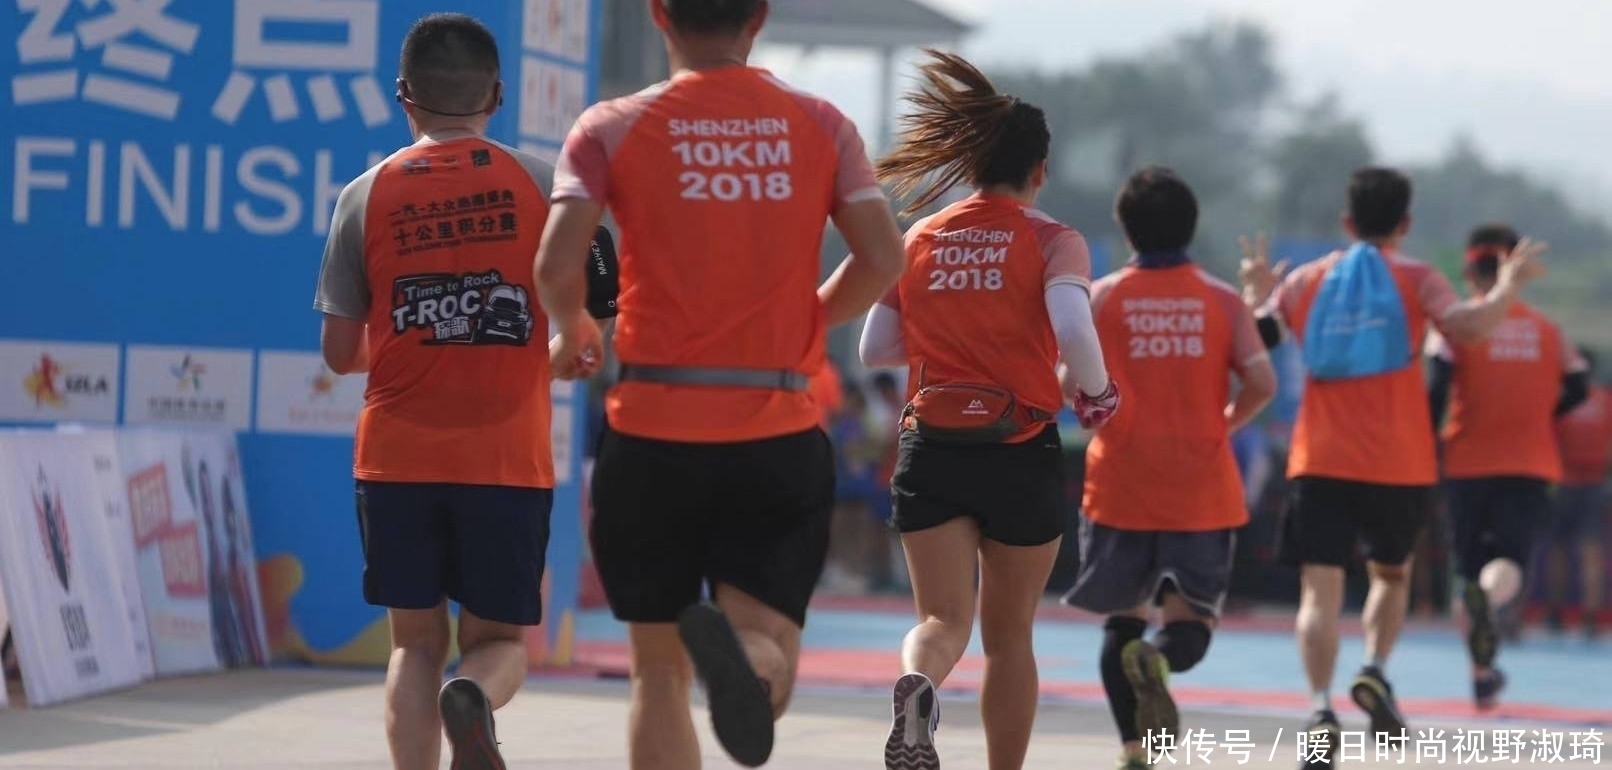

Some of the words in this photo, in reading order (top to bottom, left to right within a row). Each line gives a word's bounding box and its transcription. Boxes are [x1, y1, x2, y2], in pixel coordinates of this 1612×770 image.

[12, 0, 391, 128] 终点
[668, 118, 789, 136] SHENZHEN
[672, 140, 791, 167] 10KM
[678, 171, 792, 201] 2018
[931, 246, 1008, 265] 10KM
[405, 284, 443, 302] Time
[448, 281, 459, 293] to
[464, 271, 499, 288] Rock
[928, 268, 1004, 291] 2018
[393, 290, 481, 331] T-ROC
[1123, 313, 1205, 333] 10KM
[1128, 335, 1206, 358] 2018
